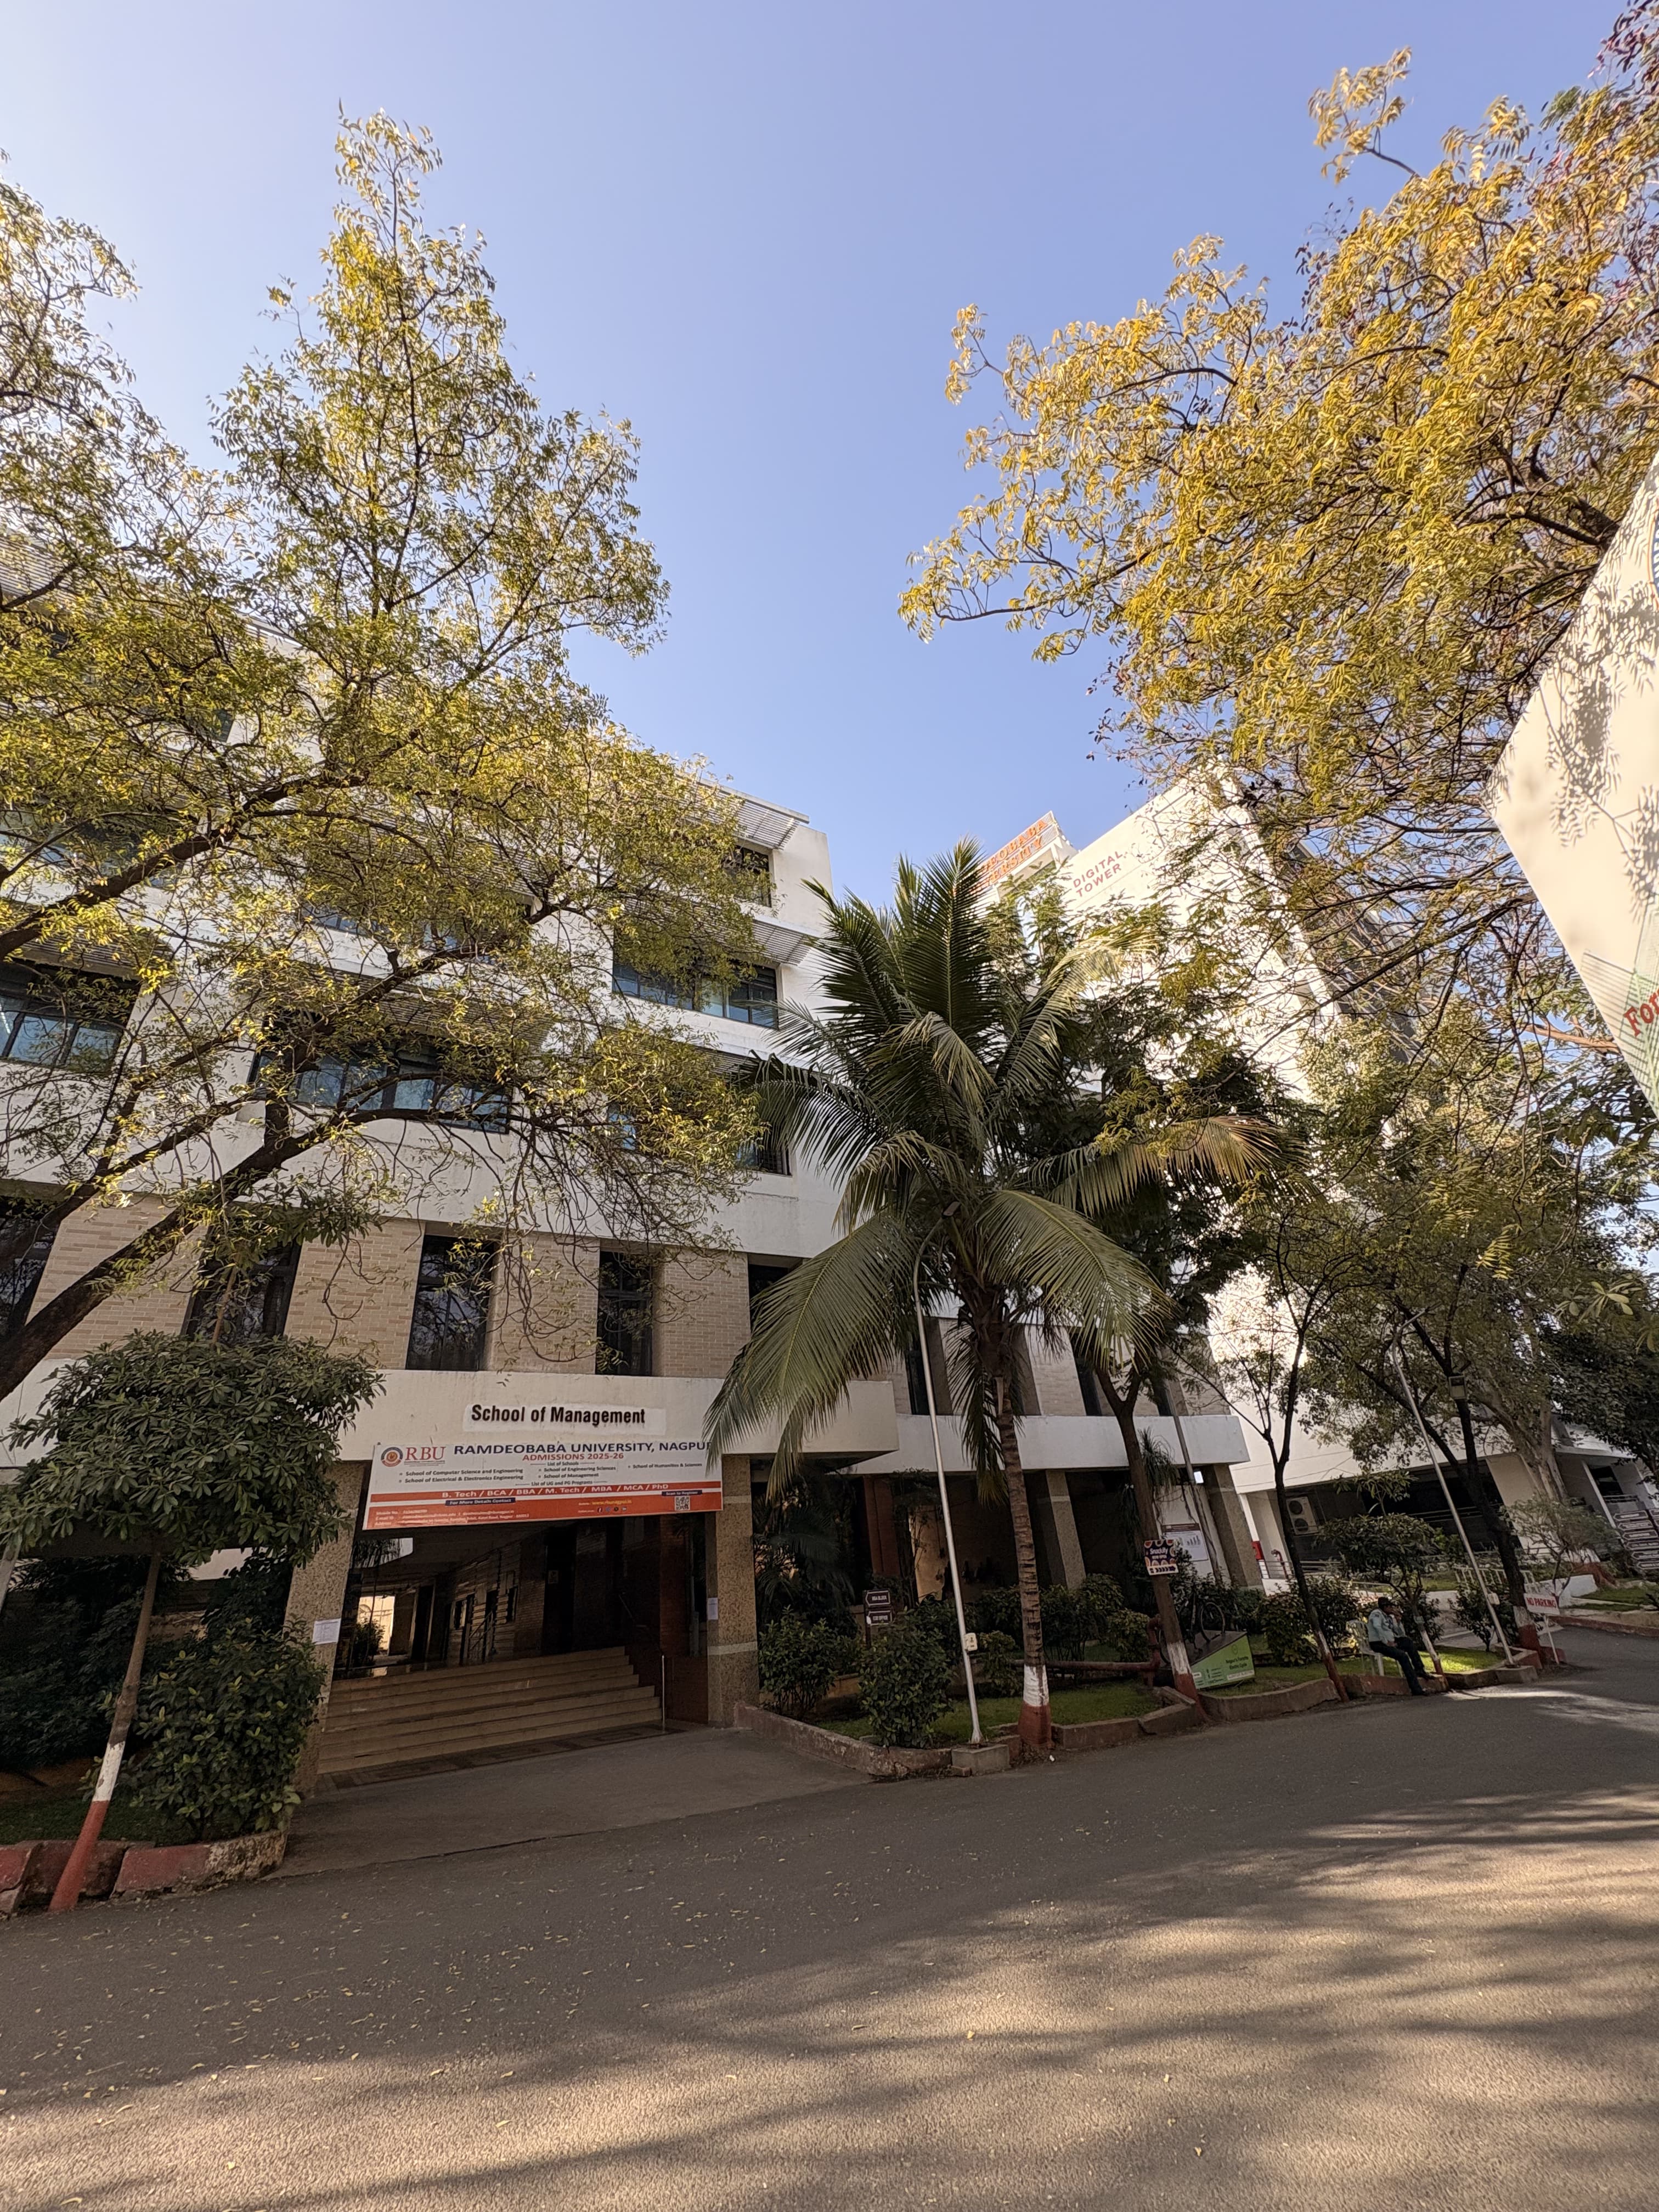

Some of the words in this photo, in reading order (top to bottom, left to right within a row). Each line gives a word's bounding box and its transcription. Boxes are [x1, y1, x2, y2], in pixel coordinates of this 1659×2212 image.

[1073, 851, 1123, 888] DIGITAL
[1076, 864, 1121, 897] TOWER
[471, 1404, 525, 1422] School
[531, 1407, 546, 1422] of
[550, 1407, 645, 1426] Management
[405, 1447, 446, 1460] RBU
[454, 1444, 567, 1454] RAMDEOBABA
[571, 1442, 654, 1453] UNIVERSITY,
[1526, 1597, 1534, 1606] NO
[1534, 1598, 1556, 1608] PARKING
